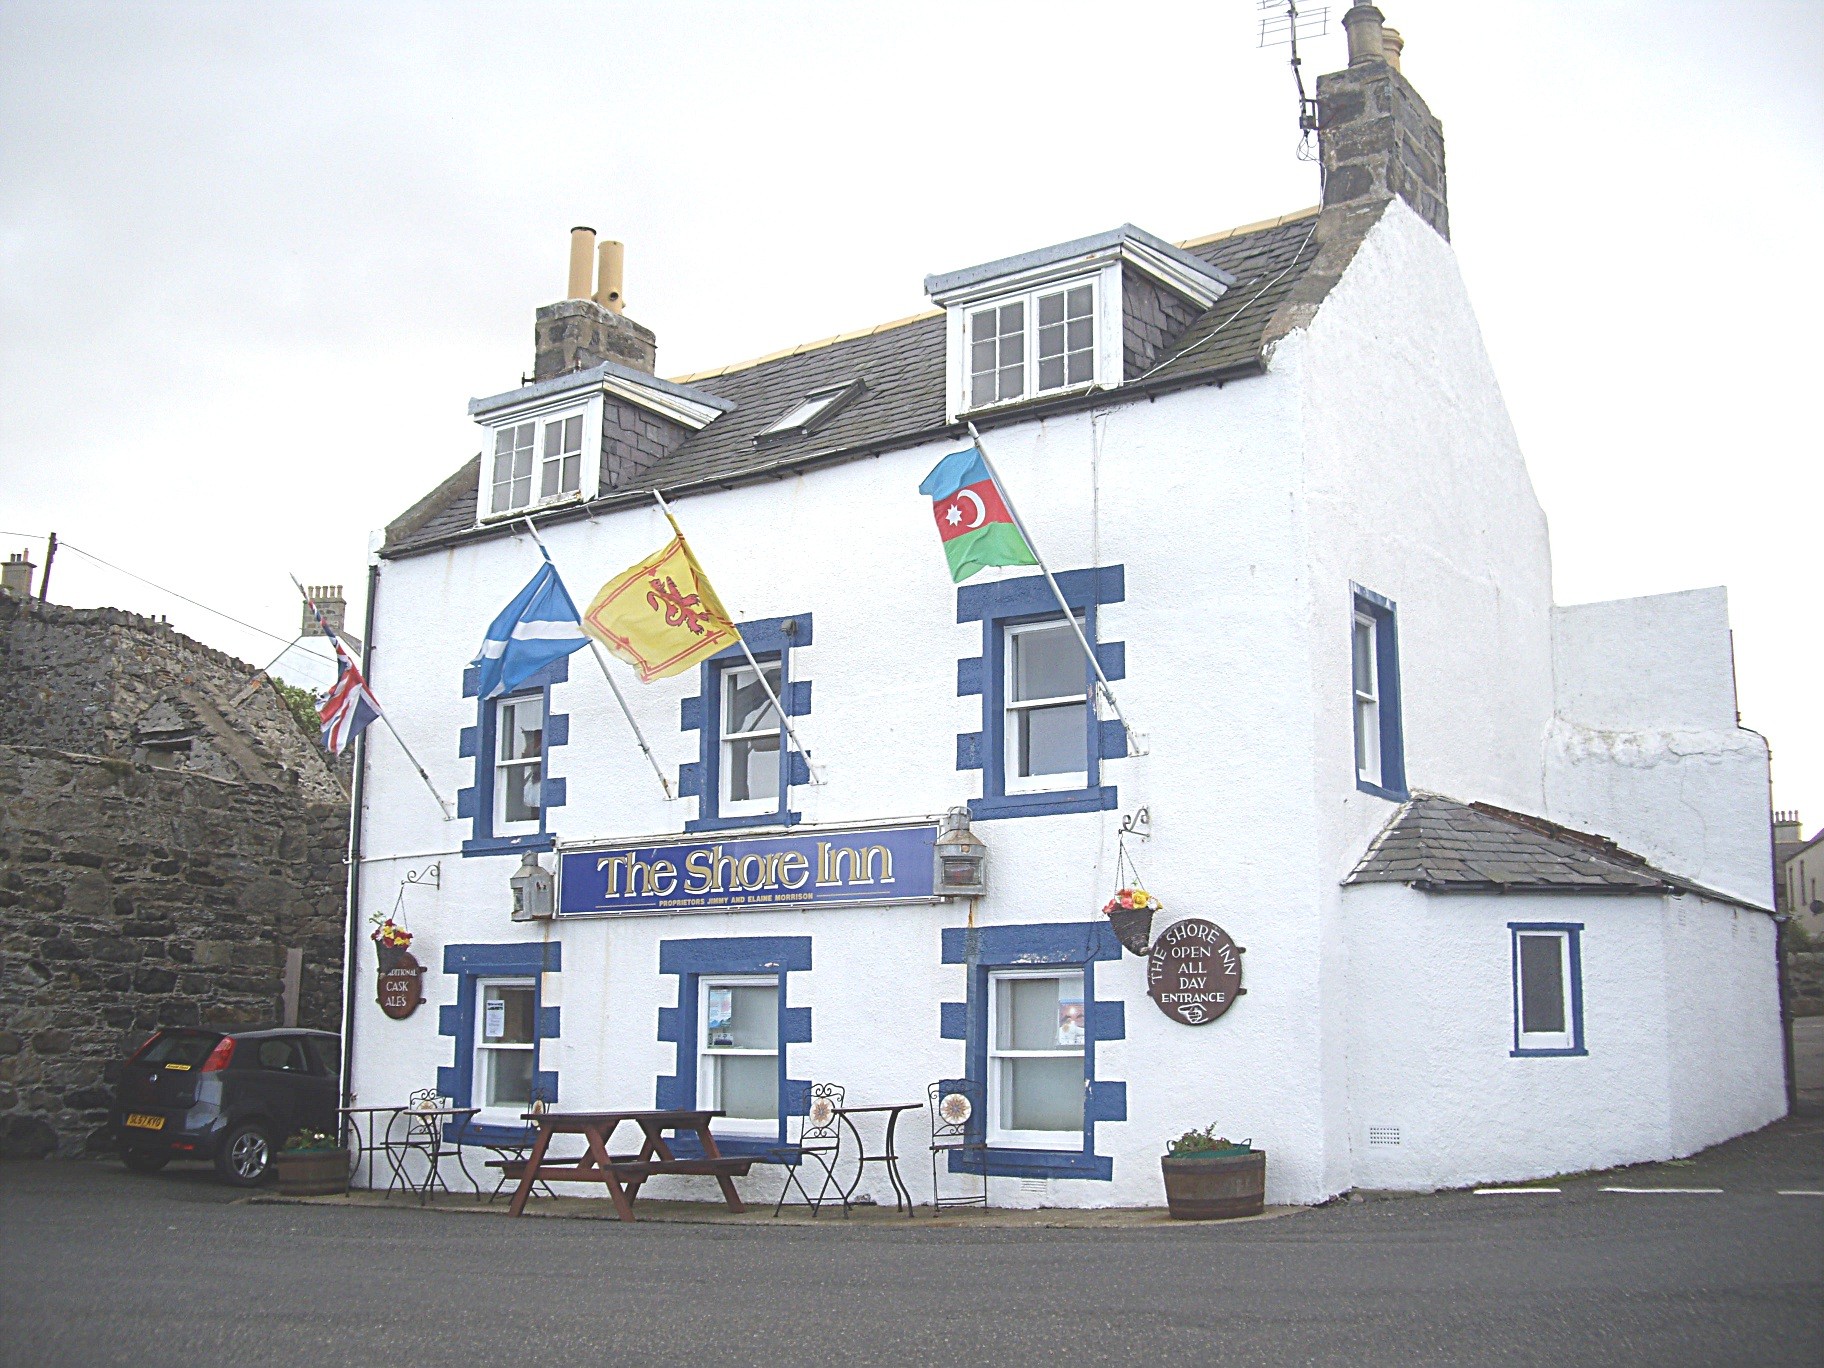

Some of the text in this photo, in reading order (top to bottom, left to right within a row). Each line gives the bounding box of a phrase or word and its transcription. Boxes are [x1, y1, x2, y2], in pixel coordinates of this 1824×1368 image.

[597, 841, 895, 898] The Shore Inn
[659, 892, 814, 907] PROPRIETORS JIMMY AND ELAINE MORRISON
[1151, 923, 1237, 985] THE SHORE INN
[1171, 946, 1211, 958] OPEN
[1178, 962, 1207, 974] ALL
[386, 981, 409, 992] CASK
[1179, 977, 1207, 989] DAY
[385, 995, 407, 1007] ALES
[1161, 992, 1225, 1003] ENTRANCE
